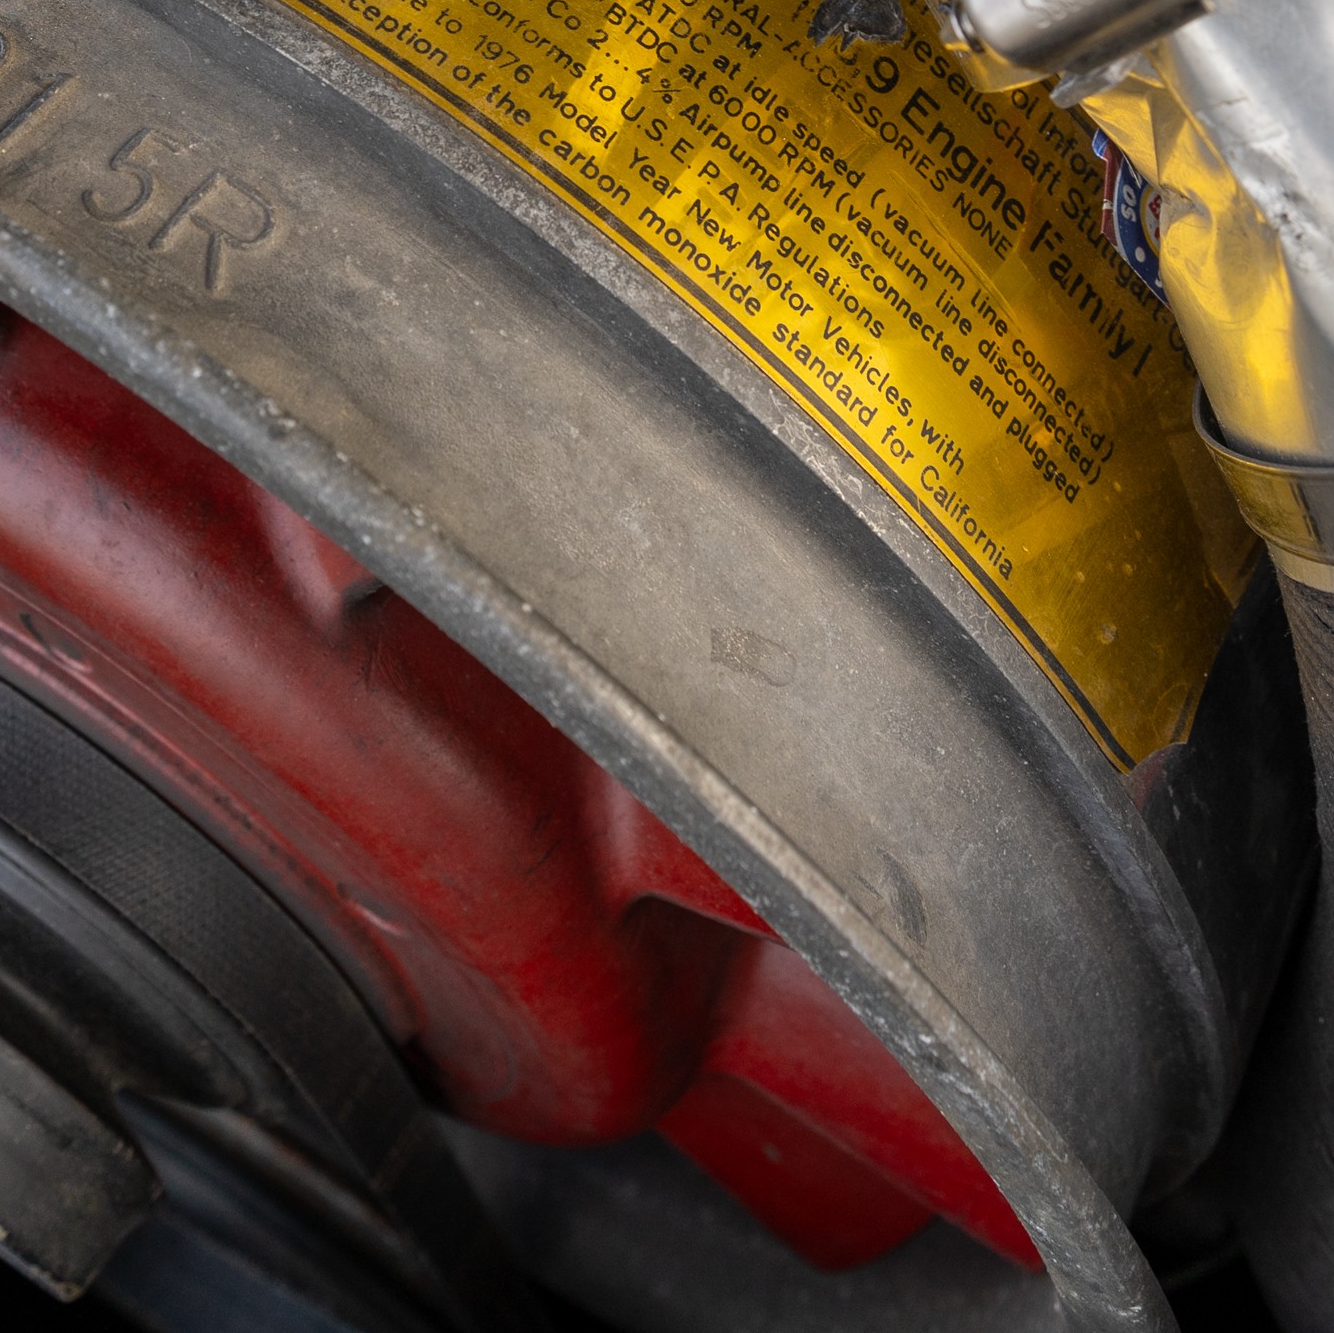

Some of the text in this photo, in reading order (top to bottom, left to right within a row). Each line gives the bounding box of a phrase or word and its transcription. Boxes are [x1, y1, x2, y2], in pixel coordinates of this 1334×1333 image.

[703, 5, 763, 58] RPM
[80, 126, 282, 298] 5R
[434, 7, 464, 35] to
[472, 33, 535, 84] 1976
[538, 82, 618, 149] Model
[628, 146, 682, 200] Year
[685, 198, 742, 253] New
[745, 250, 815, 317] Motor
[822, 315, 914, 427] Vehicles,
[919, 418, 965, 476] with
[451, 64, 488, 90] of
[482, 84, 532, 128] the
[538, 128, 631, 206] carbon
[637, 205, 762, 317] monoxide
[771, 321, 879, 428] standard
[880, 424, 915, 465] for
[920, 464, 1014, 581] California
[546, 0, 582, 31] Co
[679, 102, 781, 193] Airpump
[783, 187, 827, 235] line
[827, 230, 971, 376] disconnected
[969, 374, 1009, 419] and
[1005, 417, 1080, 504] plugged
[589, 73, 617, 102] to
[747, 202, 886, 340] Regulations
[604, 2, 678, 63] BTDC
[678, 63, 707, 90] at
[708, 84, 777, 146] 6000
[777, 140, 837, 199] RPM
[935, 288, 973, 337] line
[977, 338, 1101, 485] disconnected)
[712, 54, 743, 80] at
[744, 76, 789, 123] idle
[792, 122, 866, 189] speed
[970, 288, 1008, 337] line
[1011, 338, 1114, 463] connected)
[900, 86, 1026, 232] Engine
[1029, 219, 1134, 360] Family
[952, 192, 1014, 261] NONE
